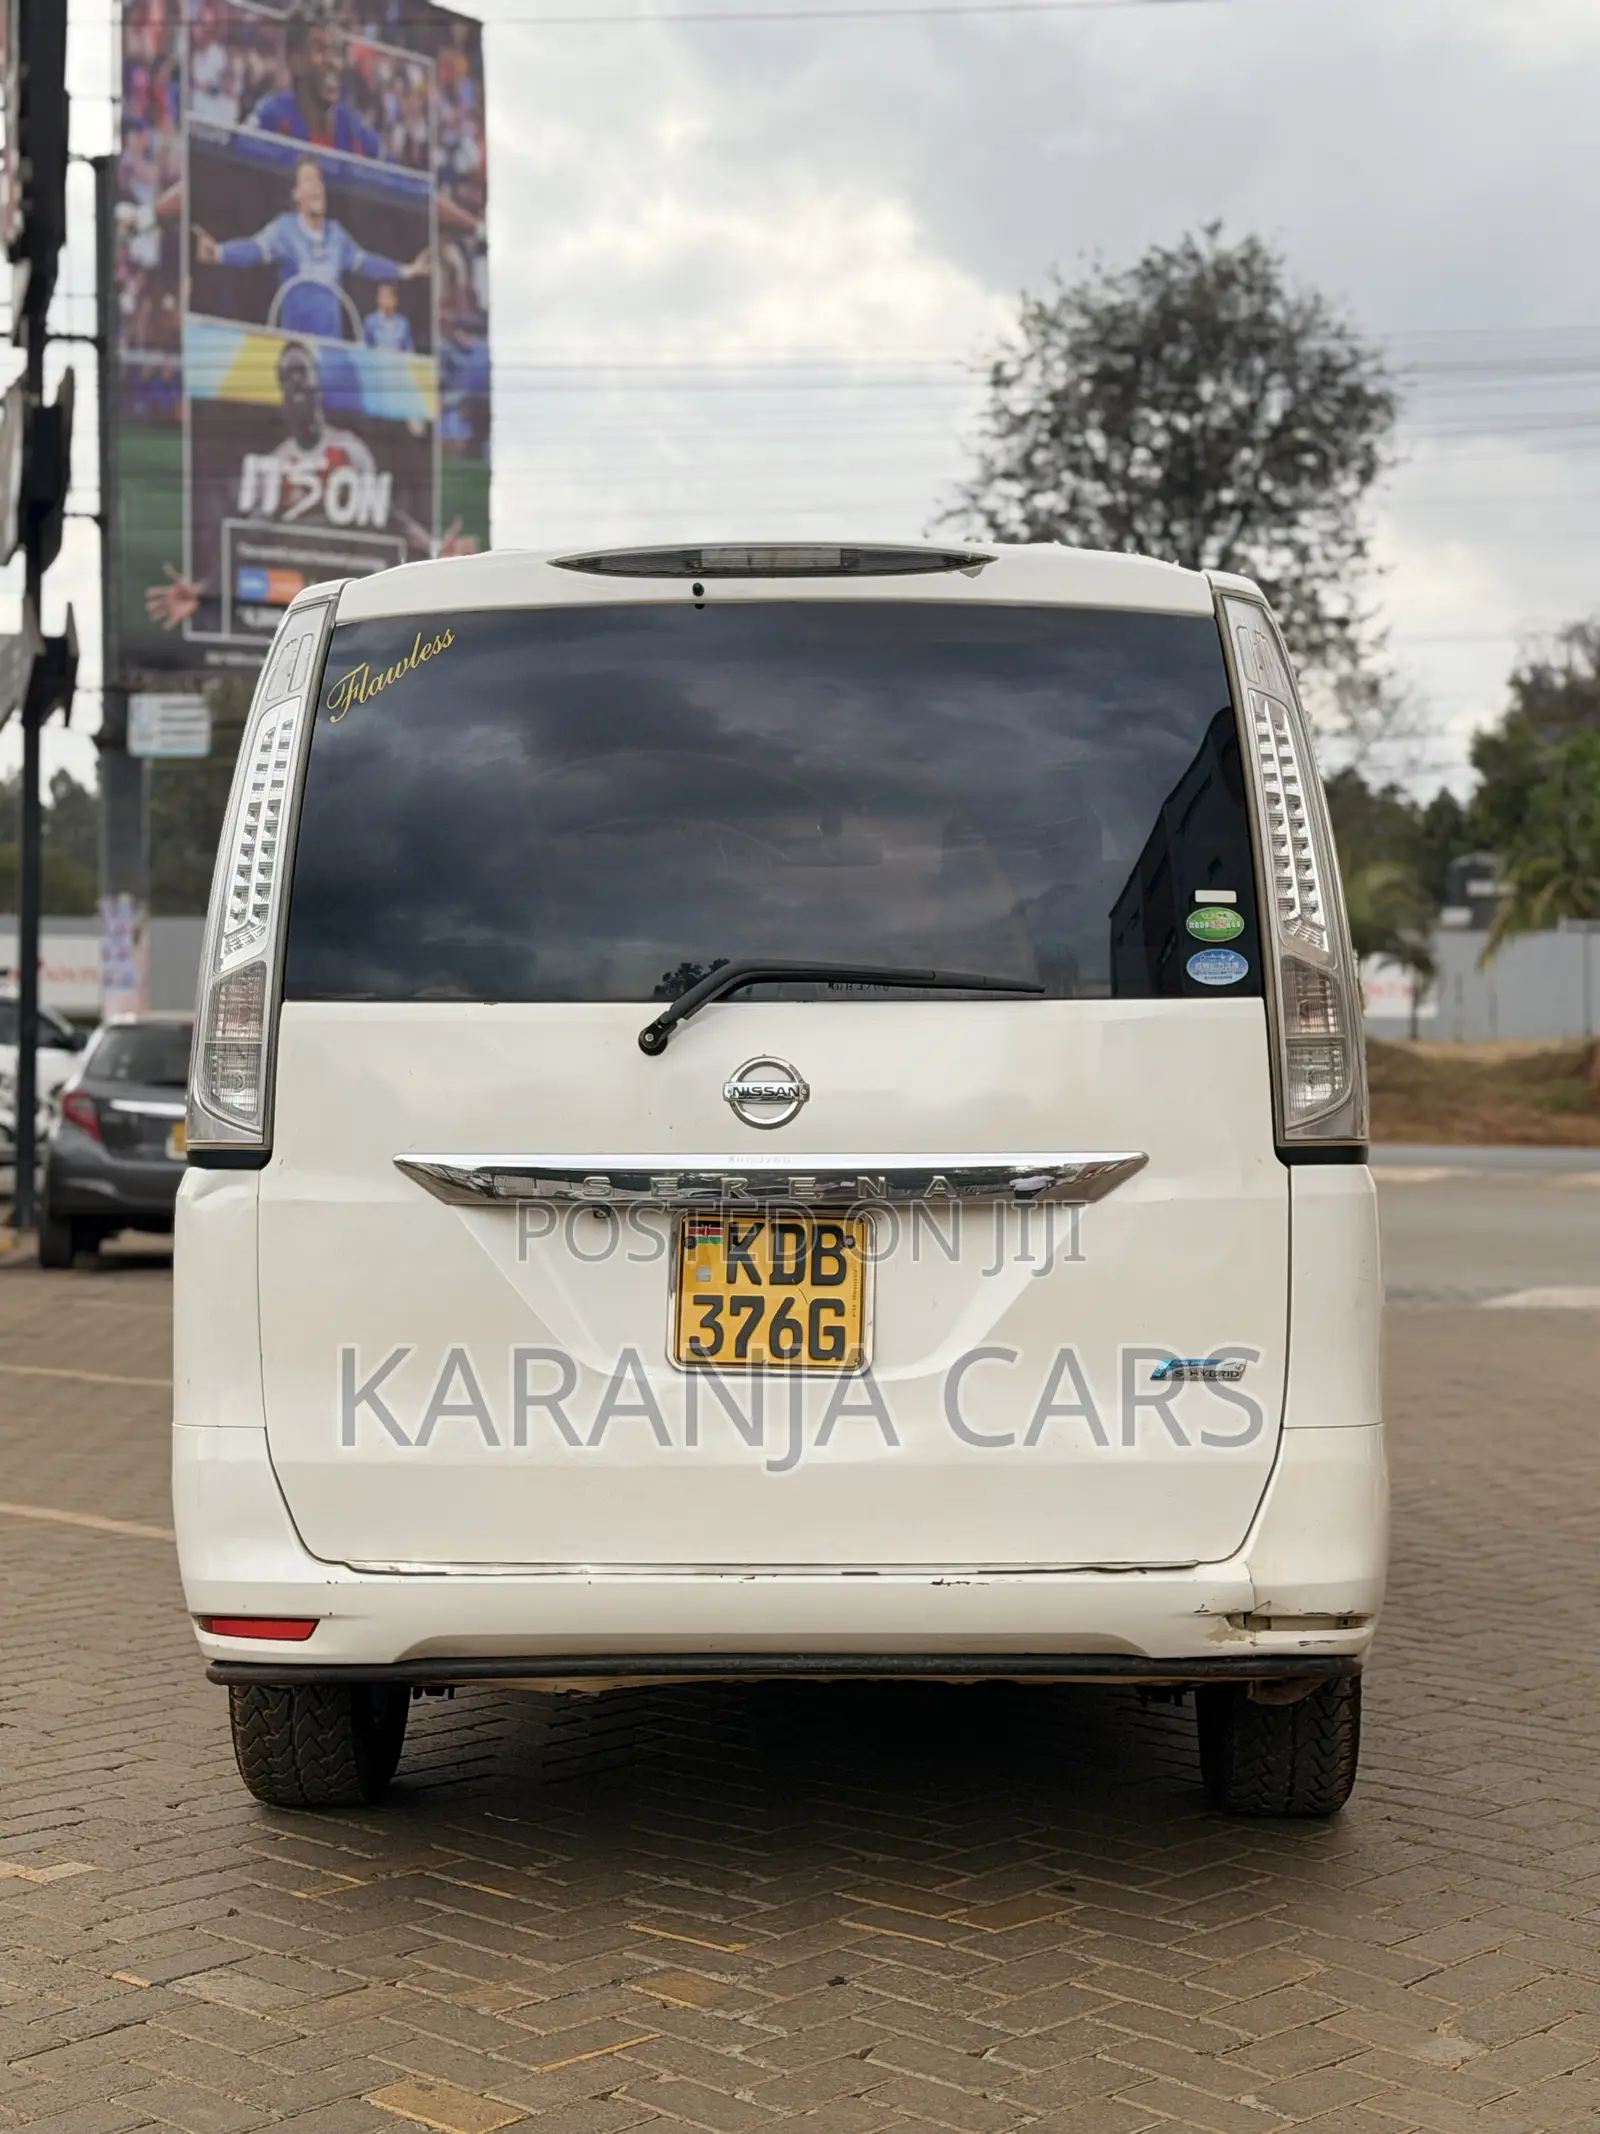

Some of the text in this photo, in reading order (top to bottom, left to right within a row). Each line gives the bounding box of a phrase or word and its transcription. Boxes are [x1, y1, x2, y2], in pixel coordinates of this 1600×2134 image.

[324, 465, 393, 528] ON
[326, 628, 455, 723] Flawless
[733, 1086, 800, 1097] NISSAN
[582, 1175, 958, 1199] SERENA
[726, 1222, 847, 1286] KDB
[688, 1295, 845, 1361] 376G
